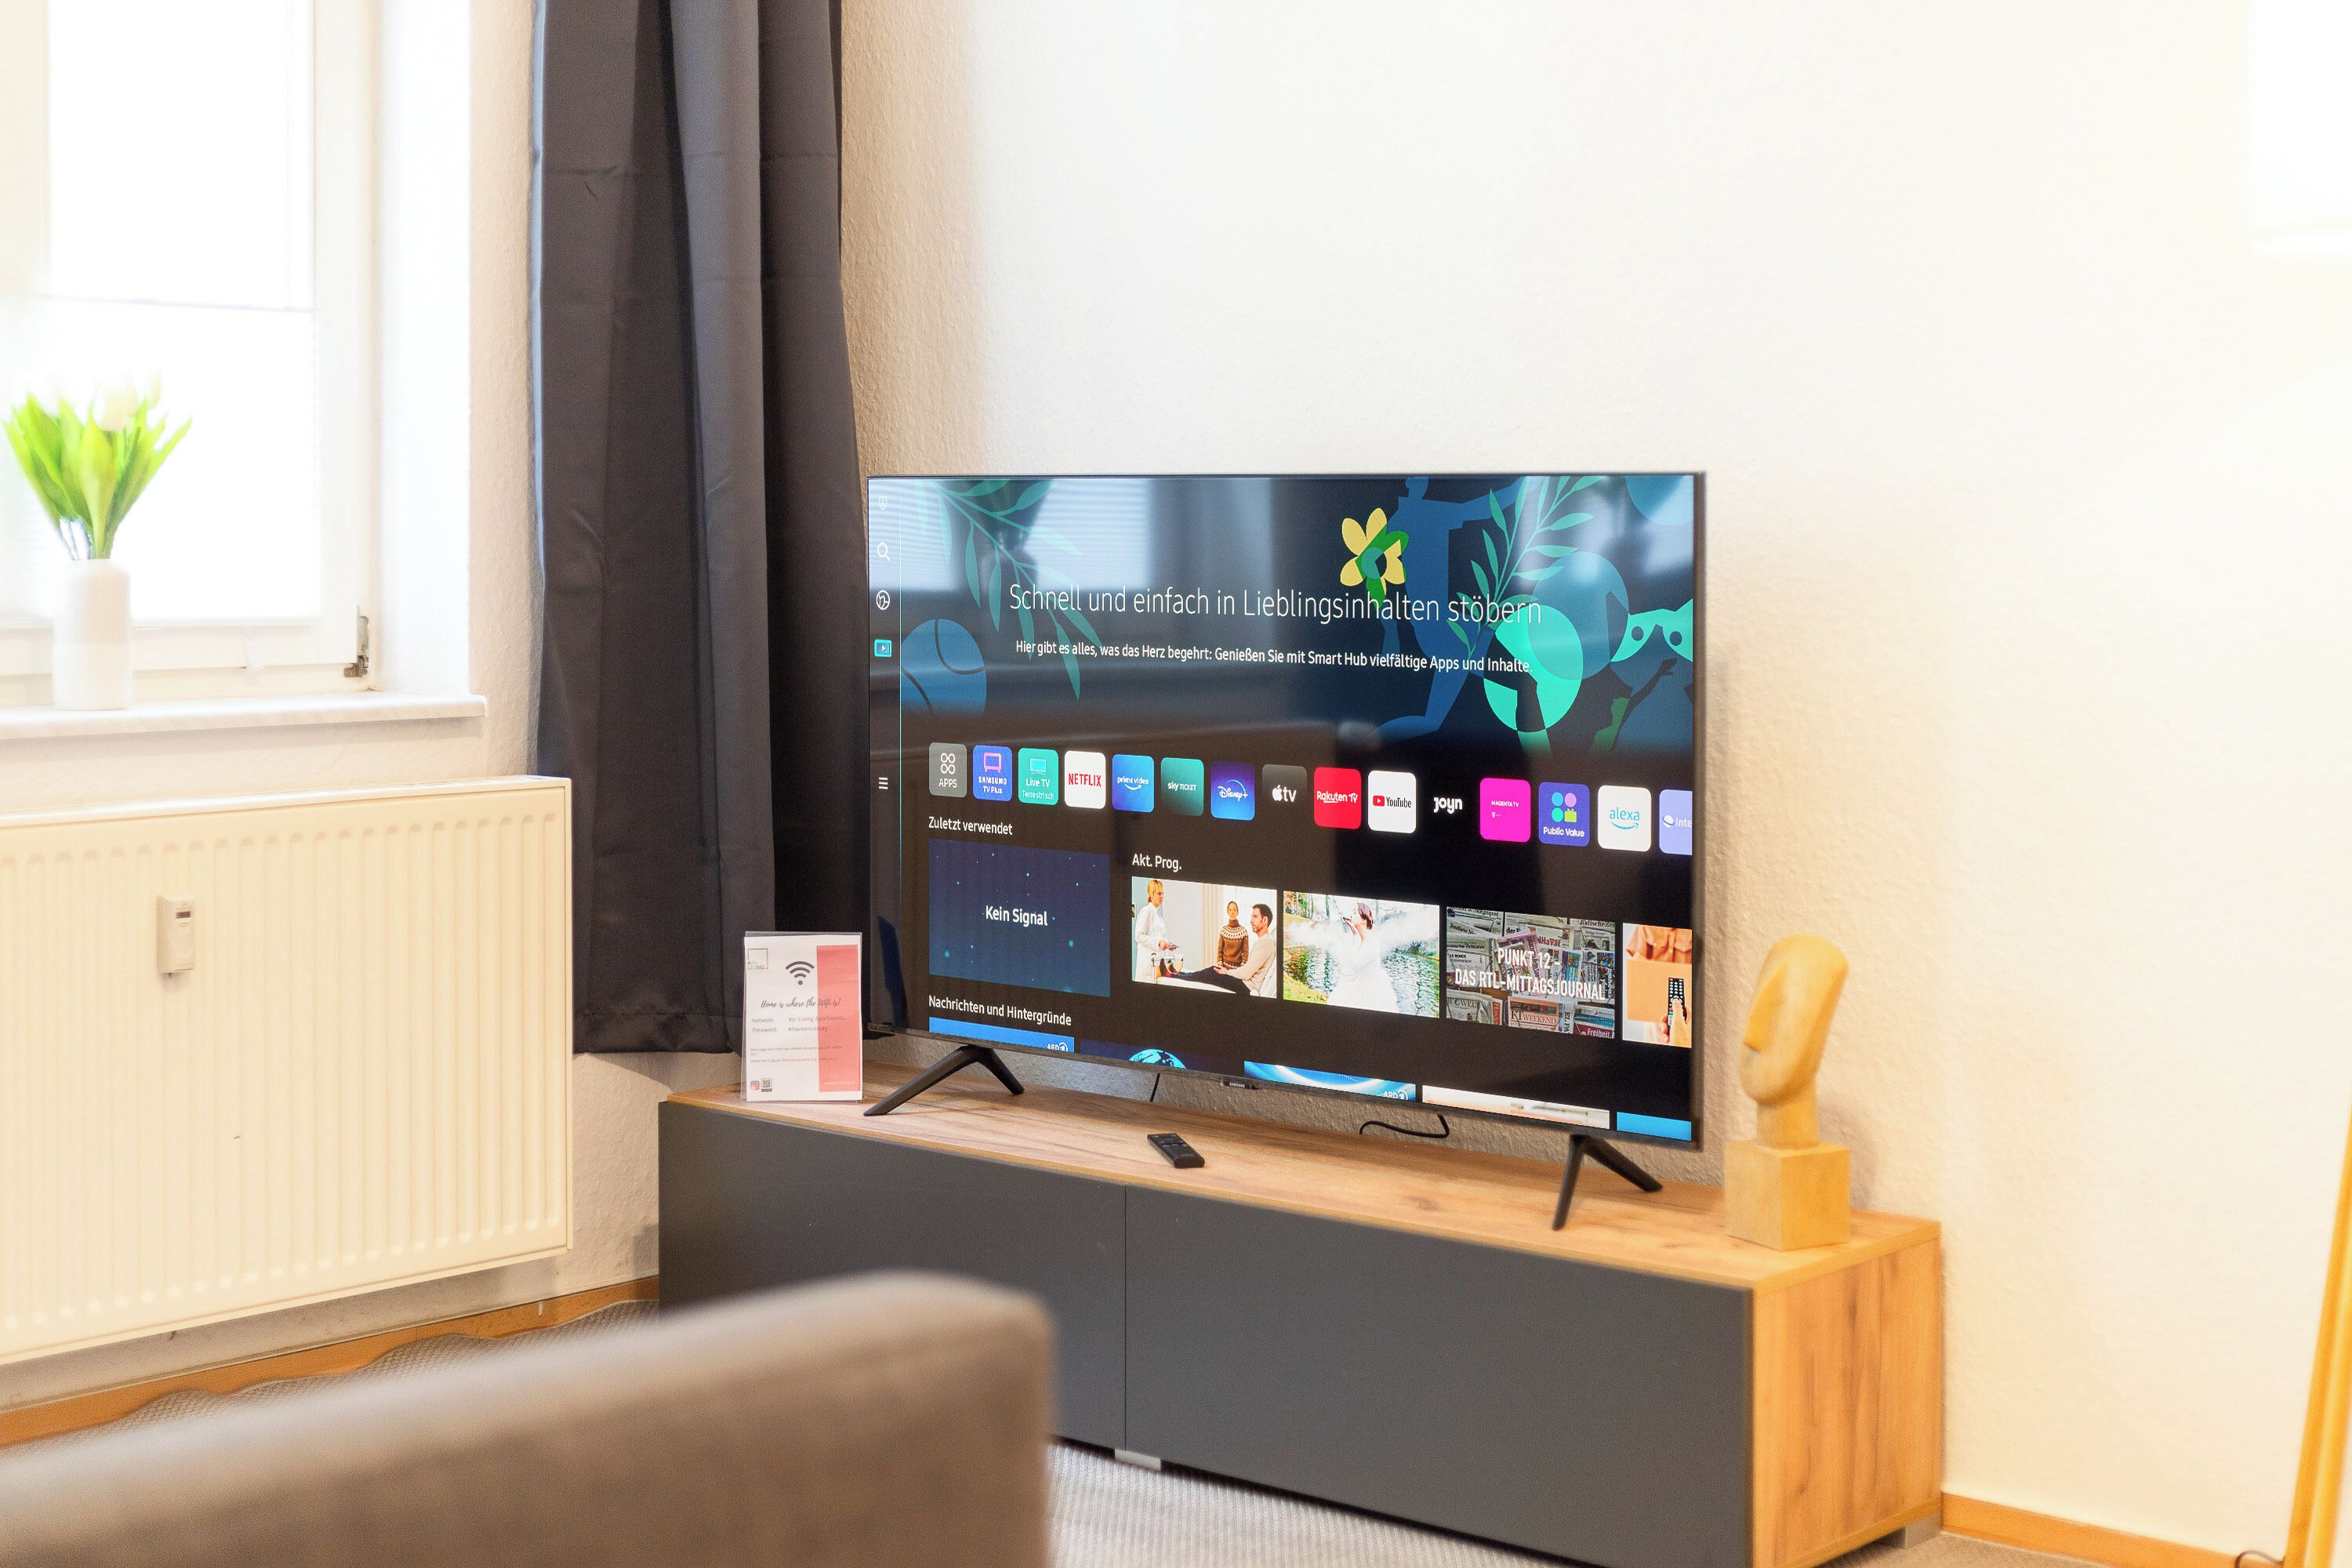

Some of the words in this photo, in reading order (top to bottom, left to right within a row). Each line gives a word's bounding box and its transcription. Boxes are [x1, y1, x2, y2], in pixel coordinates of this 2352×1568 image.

[1010, 583, 1082, 612] Schnell
[1088, 585, 1126, 613] und
[1133, 586, 1210, 615] einfach
[1217, 590, 1236, 615] in
[1244, 588, 1439, 625] Lieblingsinhalten
[1448, 593, 1541, 624] stöbern
[1016, 639, 1036, 654] Hier
[1037, 640, 1057, 656] gibt
[1059, 644, 1070, 655] es
[1072, 641, 1098, 659] alles,
[1100, 645, 1120, 657] was
[1122, 642, 1140, 658] das
[1142, 643, 1166, 659] Herz
[1168, 644, 1212, 663] begehrt:
[1215, 645, 1265, 663] Genießen
[1267, 648, 1285, 663] Sie
[1287, 648, 1305, 664] mit
[1308, 650, 1342, 666] Smart
[1345, 652, 1367, 667] Hub
[1370, 652, 1428, 672] vielfältige
[1429, 654, 1460, 673] Apps
[1462, 656, 1484, 671] und
[1487, 657, 1533, 673] Inhalte.
[938, 778, 957, 789] APPS
[1025, 778, 1040, 787] Live
[1041, 779, 1051, 788] TV
[1068, 772, 1102, 788] NETFLIX
[1117, 775, 1134, 786] prime
[1134, 776, 1149, 785] video
[1167, 781, 1179, 791] sky
[1179, 782, 1197, 792] TICKET
[1022, 789, 1054, 800] Terrestrisch
[1316, 790, 1348, 804] Rakuten
[1348, 793, 1358, 804] TV
[1385, 797, 1412, 809] YouTube
[1610, 807, 1640, 822] alexa
[928, 816, 960, 831] Zuletzt
[963, 819, 1013, 835] verwendet
[1543, 826, 1564, 837] Public
[1565, 828, 1585, 838] Value
[1132, 853, 1152, 867] Akt.
[1155, 855, 1182, 873] Prog.
[985, 905, 1010, 922] Kein
[1012, 908, 1048, 927] Signal
[1497, 948, 1534, 967] PUNKT
[1538, 952, 1551, 969] 12
[1455, 969, 1476, 988] DAS
[1479, 971, 1606, 1000] RTL-MITTAGSJOURNAL
[928, 994, 985, 1014] Nachrichten
[986, 1004, 1004, 1018] und
[1007, 1006, 1072, 1026] Hintergründe
[1383, 1091, 1398, 1099] ARD
